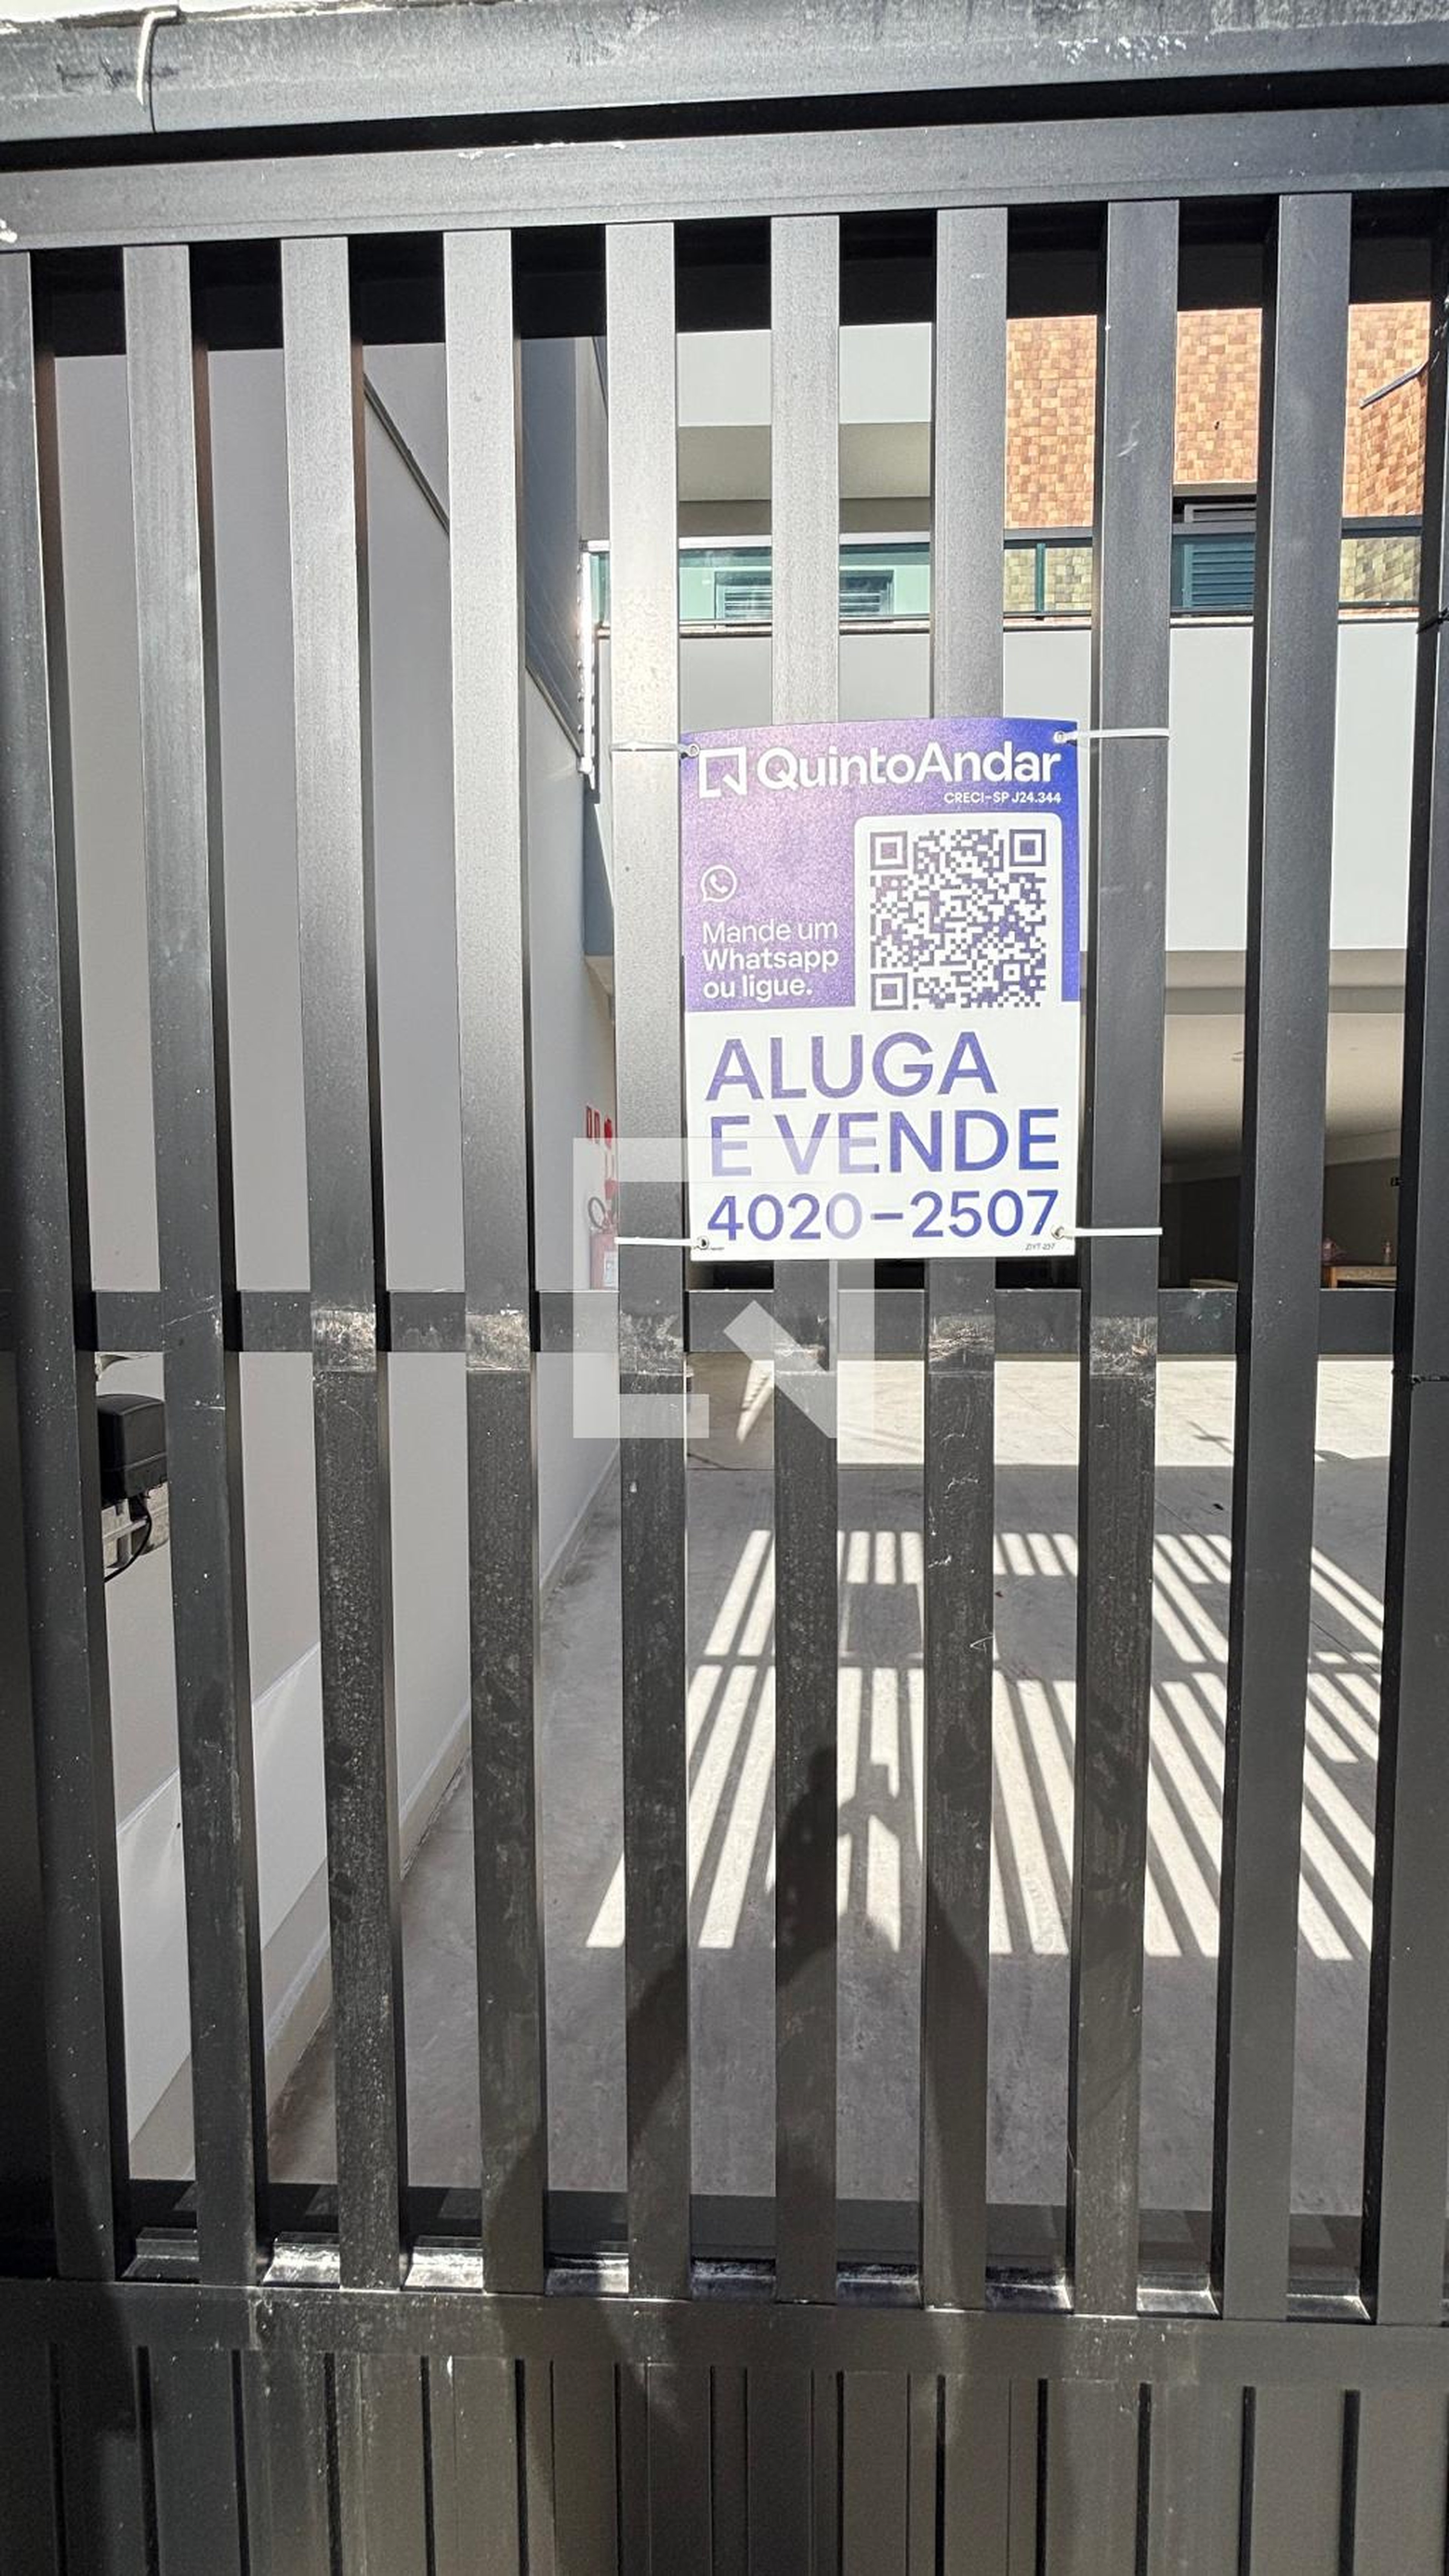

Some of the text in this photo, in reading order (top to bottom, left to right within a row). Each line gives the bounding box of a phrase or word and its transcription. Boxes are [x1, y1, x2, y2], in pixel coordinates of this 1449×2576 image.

[757, 741, 1061, 791] QuintoAndar
[944, 791, 1061, 804] CRECI-SP J24.344
[703, 919, 837, 944] Mande um
[702, 948, 838, 973] Whatsapp
[703, 974, 812, 1002] ou ligue.
[706, 1031, 998, 1101] ALUGA
[711, 1109, 1059, 1176] E VENDE
[708, 1189, 1058, 1241] 4020-2507
